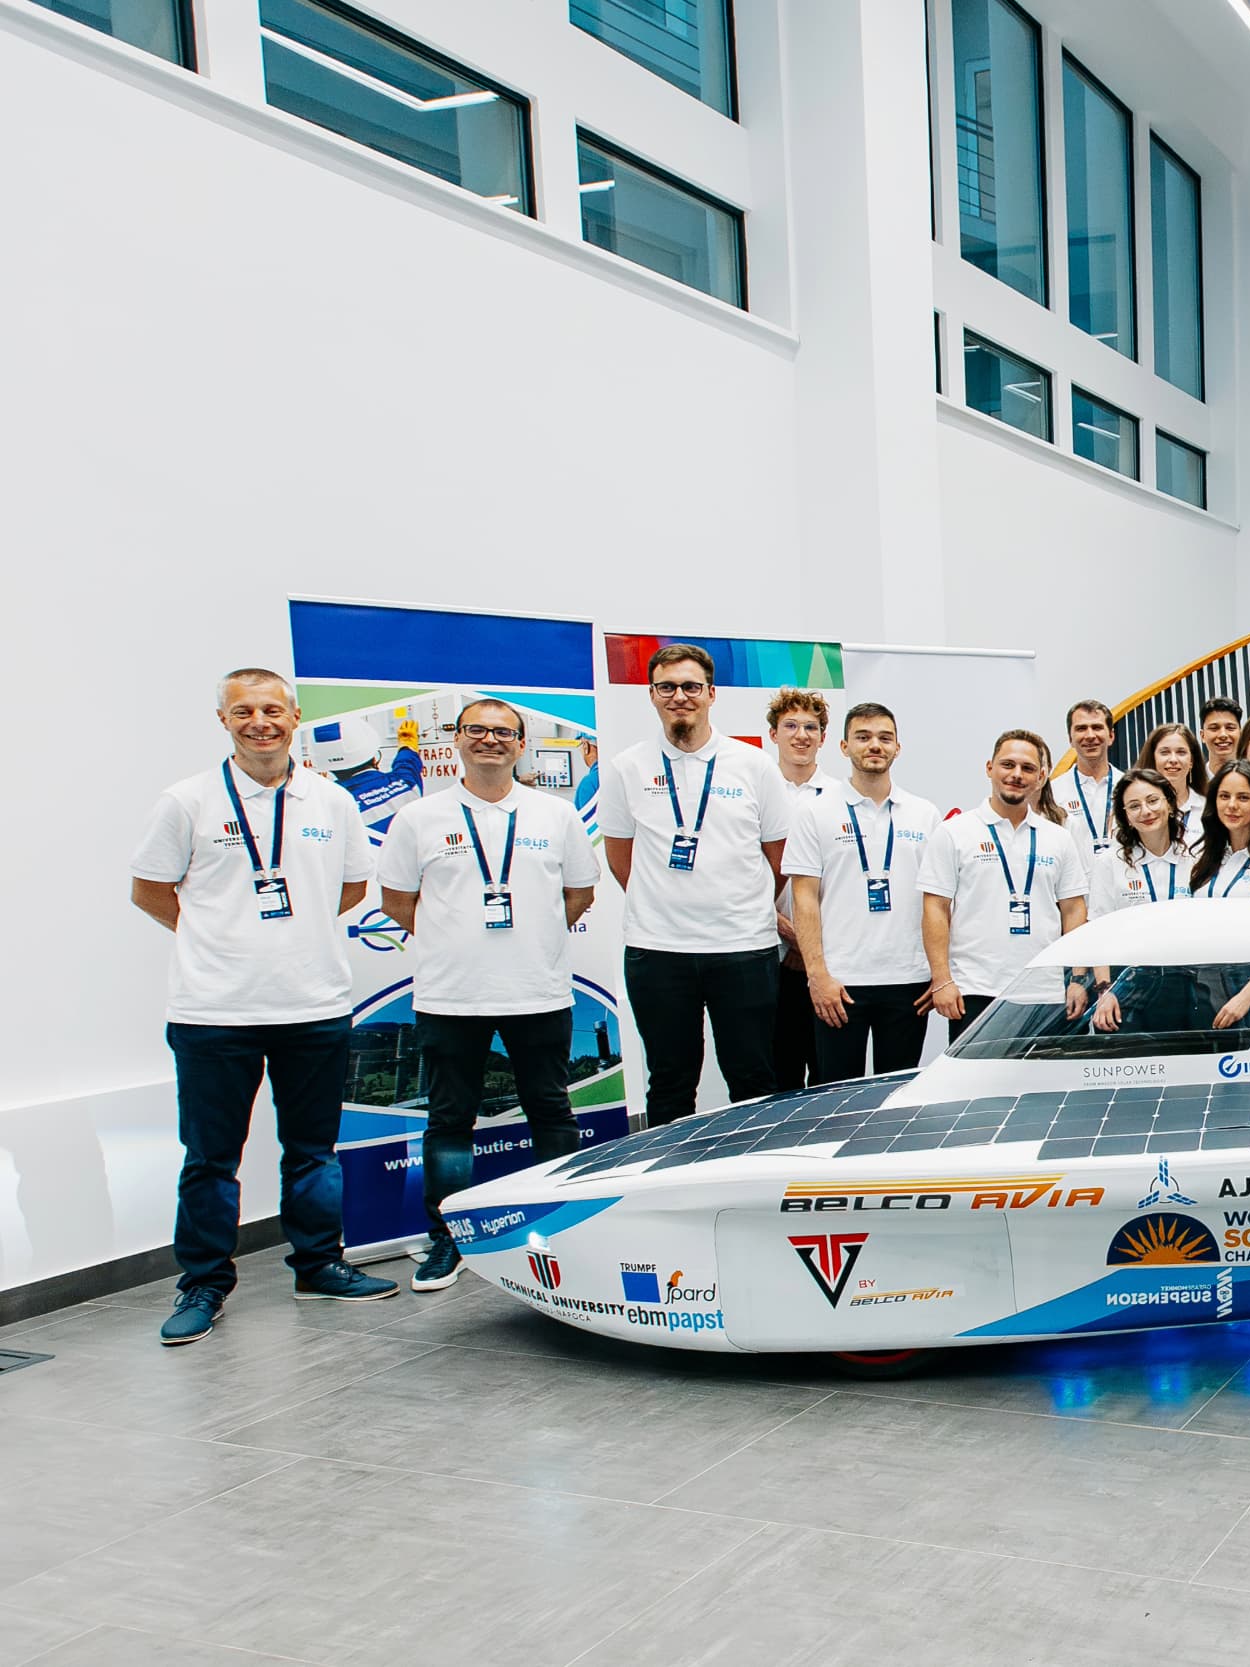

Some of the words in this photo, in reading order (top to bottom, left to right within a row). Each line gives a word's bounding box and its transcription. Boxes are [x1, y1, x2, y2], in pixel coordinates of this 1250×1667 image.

[1083, 1063, 1166, 1078] SUNPOWER
[970, 1182, 1104, 1210] AVIA
[480, 1210, 526, 1235] Hyperion
[620, 1263, 657, 1272] TRUMPF
[859, 1280, 876, 1288] BY
[500, 1276, 549, 1303] TECHNICAL
[551, 1295, 625, 1316] UNIVERSITY
[911, 1288, 953, 1301] AVIA
[628, 1306, 724, 1332] ebmpapst
